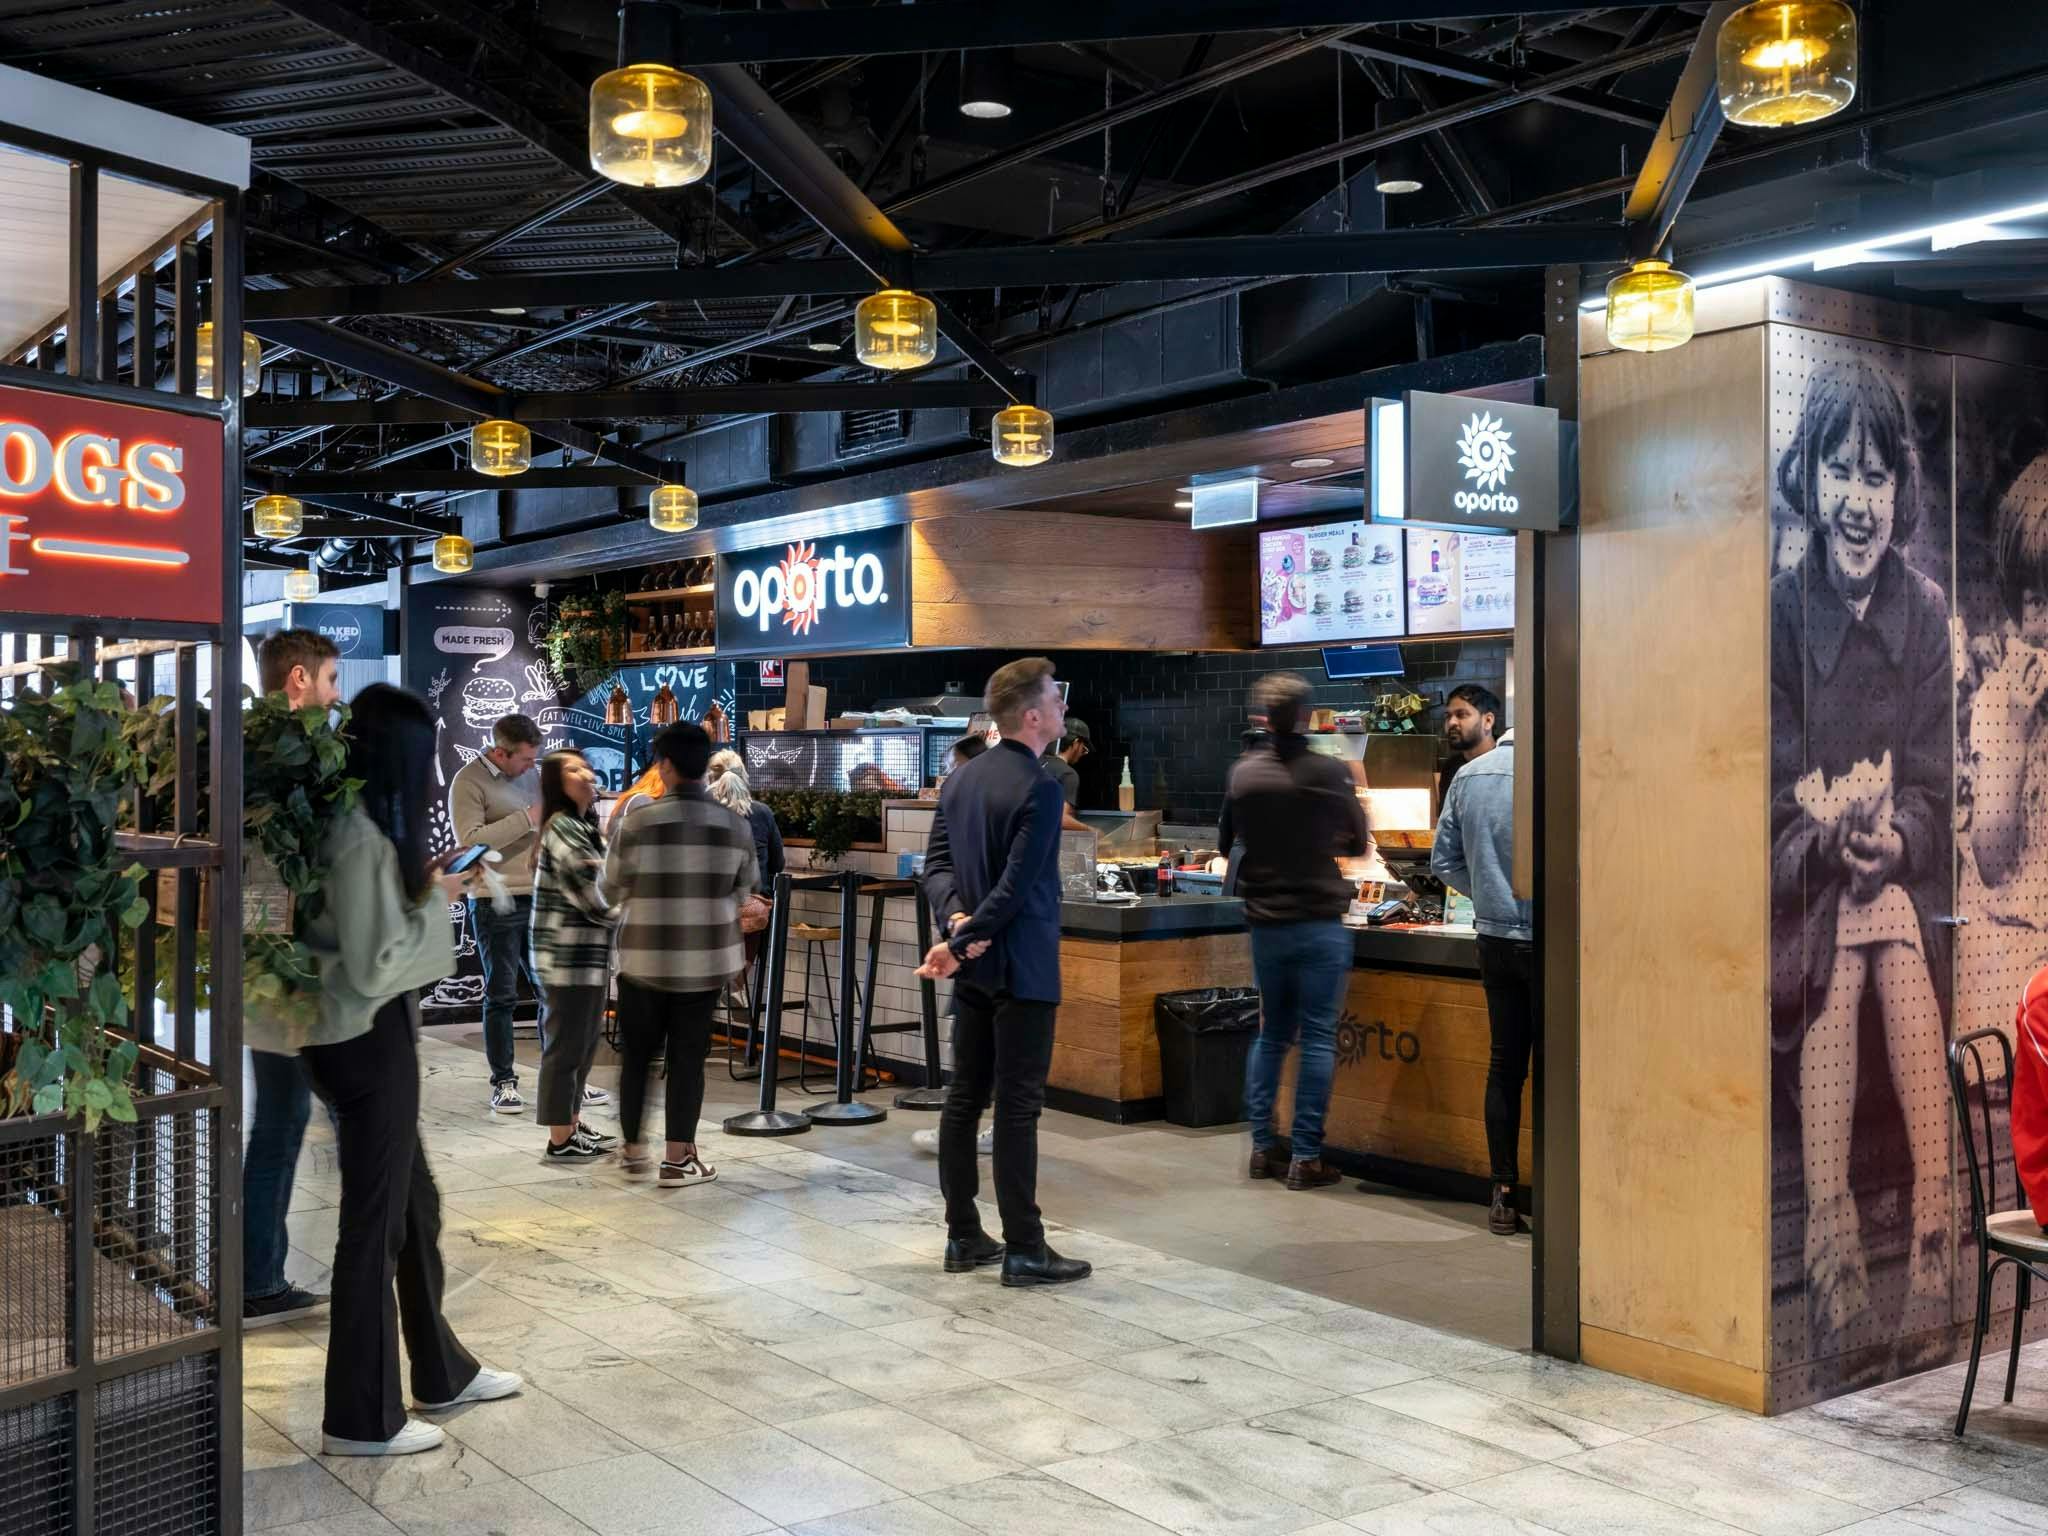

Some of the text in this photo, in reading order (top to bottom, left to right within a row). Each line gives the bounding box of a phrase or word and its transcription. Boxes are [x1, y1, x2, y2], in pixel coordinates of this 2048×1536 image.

[1454, 491, 1519, 514] oporto
[319, 626, 359, 636] BAKED
[441, 635, 504, 646] MADE FRESH
[640, 665, 709, 692] LOVE
[542, 711, 559, 722] EAT
[607, 725, 626, 739] SPIC
[1336, 1018, 1420, 1063] orto
